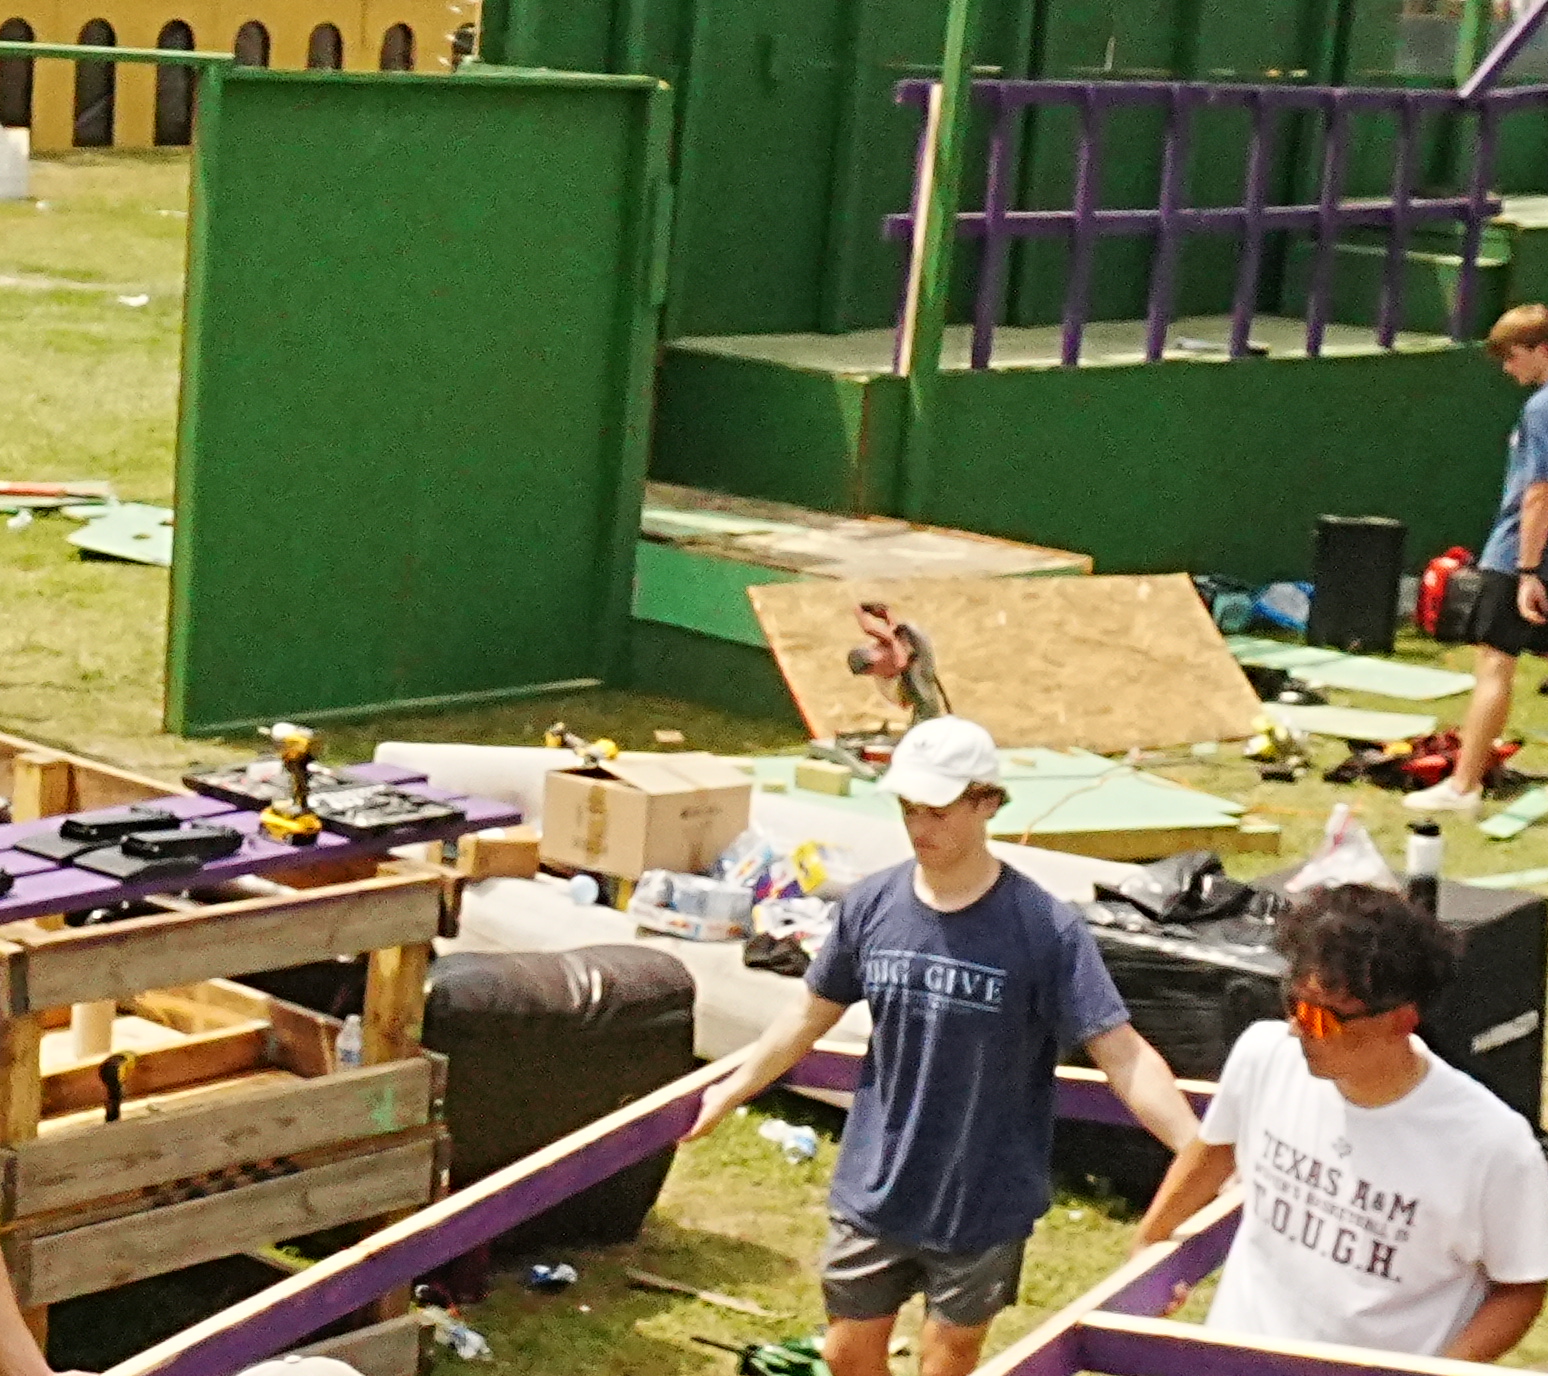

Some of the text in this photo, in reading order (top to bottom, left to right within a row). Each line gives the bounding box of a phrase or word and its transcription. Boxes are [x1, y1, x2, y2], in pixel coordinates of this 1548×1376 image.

[925, 964, 1003, 1003] GIVE
[1264, 1130, 1343, 1196] TEXAS
[1351, 1178, 1419, 1226] A&M
